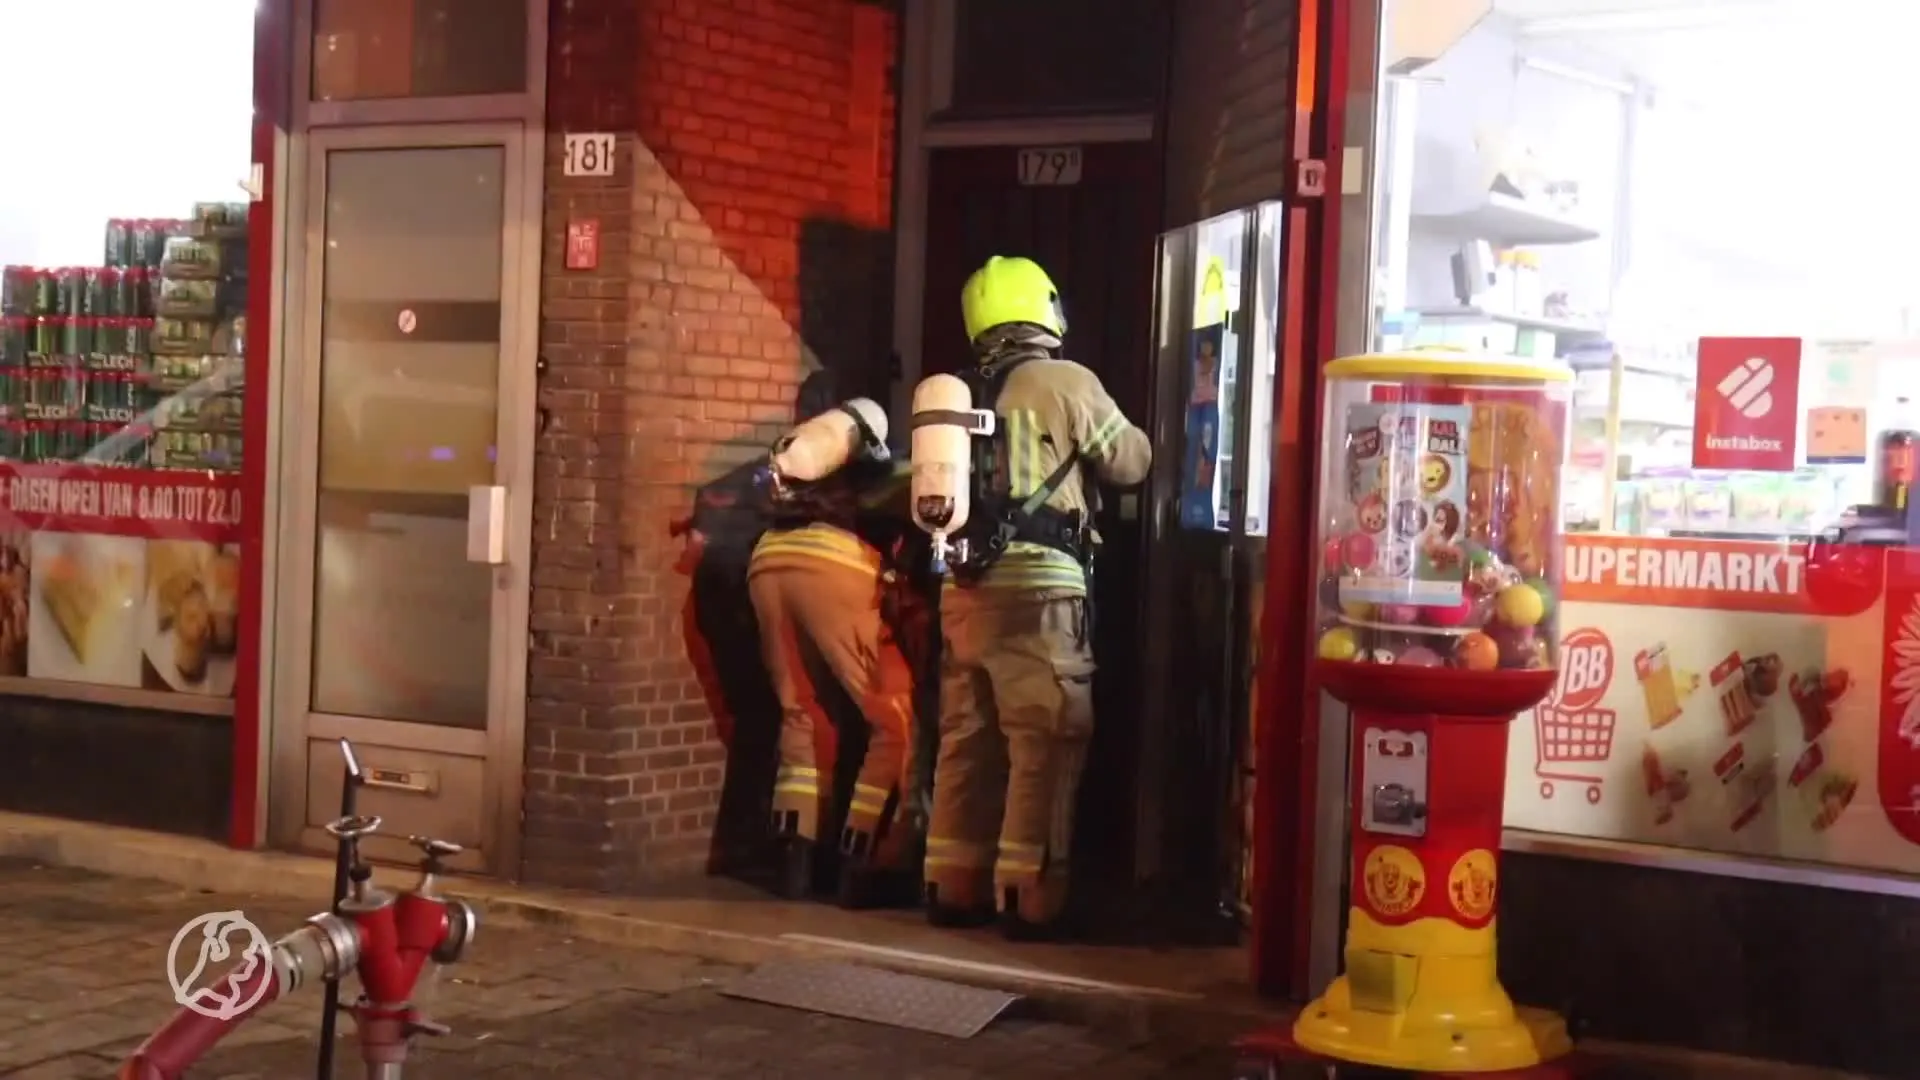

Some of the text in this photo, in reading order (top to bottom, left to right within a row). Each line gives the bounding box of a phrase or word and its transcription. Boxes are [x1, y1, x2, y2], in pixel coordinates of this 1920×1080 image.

[569, 139, 609, 172] 181
[61, 479, 100, 516] OPEN
[103, 482, 133, 518] VAN
[176, 486, 206, 521] TOT
[1565, 545, 1806, 595] UPERMARKT
